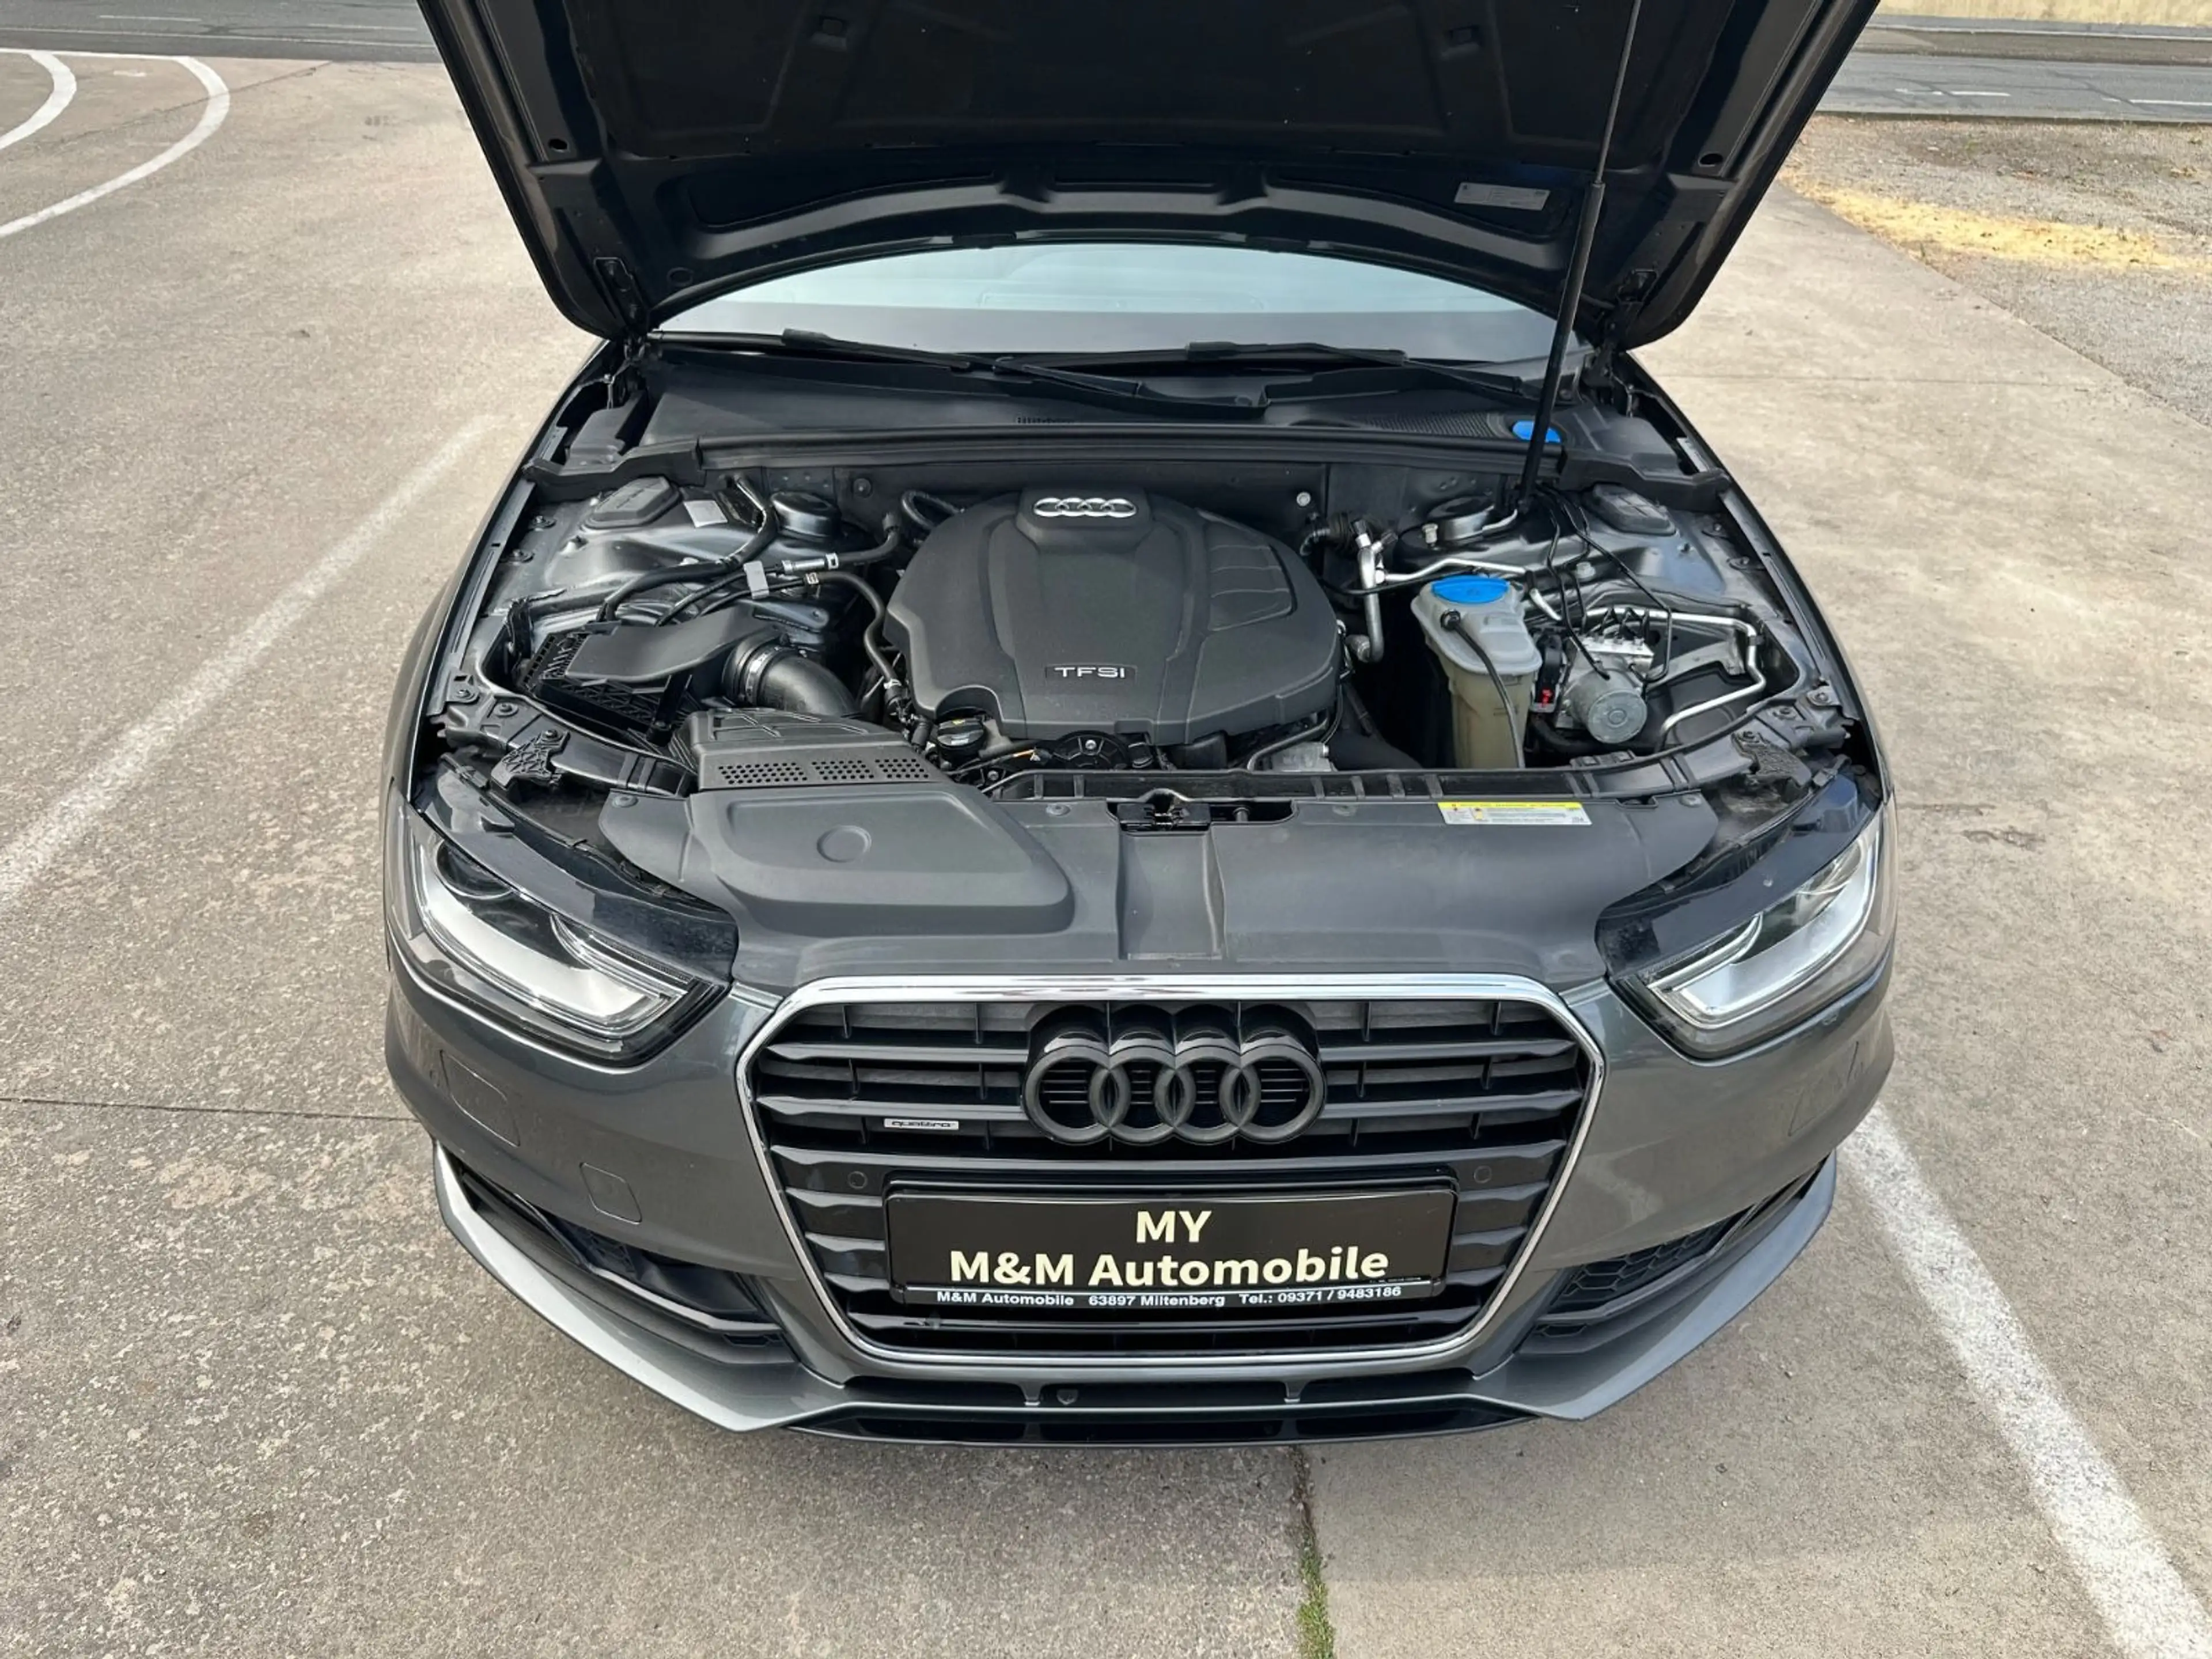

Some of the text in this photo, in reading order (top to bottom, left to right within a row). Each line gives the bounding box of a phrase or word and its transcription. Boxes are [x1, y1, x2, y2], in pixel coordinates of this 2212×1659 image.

[1054, 666, 1126, 679] TFSI
[1136, 1210, 1212, 1243] MY
[950, 1245, 1389, 1286] M&M Automobile
[937, 1291, 977, 1303] M&M
[982, 1293, 1074, 1306] Automobile
[1088, 1295, 1135, 1306] 63897
[1140, 1295, 1225, 1308] Miltenberg
[1238, 1293, 1272, 1304] Tel.:
[1277, 1290, 1323, 1304] 09371
[1338, 1286, 1402, 1300] 9483186
